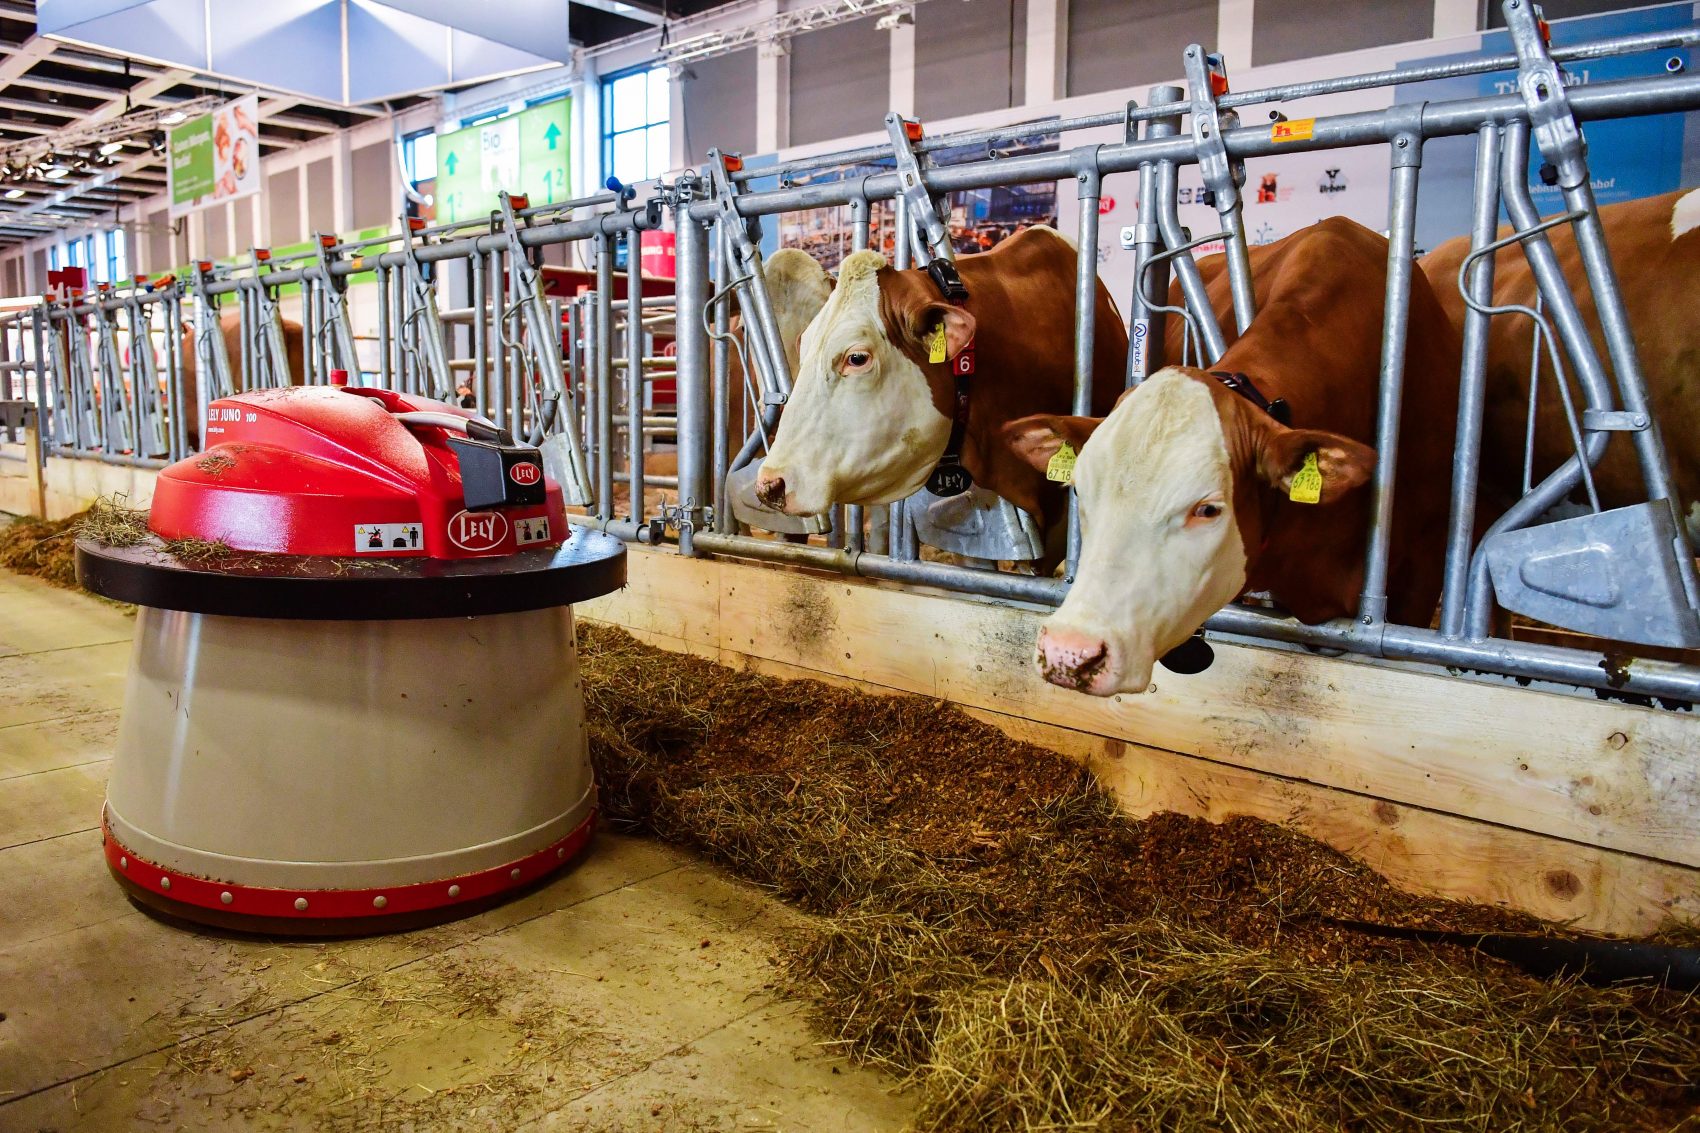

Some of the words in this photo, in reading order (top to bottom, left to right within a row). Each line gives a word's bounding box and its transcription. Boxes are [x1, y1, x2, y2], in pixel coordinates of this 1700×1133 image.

[1319, 184, 1347, 194] Urban
[960, 355, 970, 372] 6
[1133, 338, 1143, 373] Agritubel
[208, 408, 220, 421] LELY
[220, 408, 241, 422] JUNO
[246, 413, 257, 423] 100
[515, 464, 534, 480] LELY
[459, 515, 496, 544] LELY
